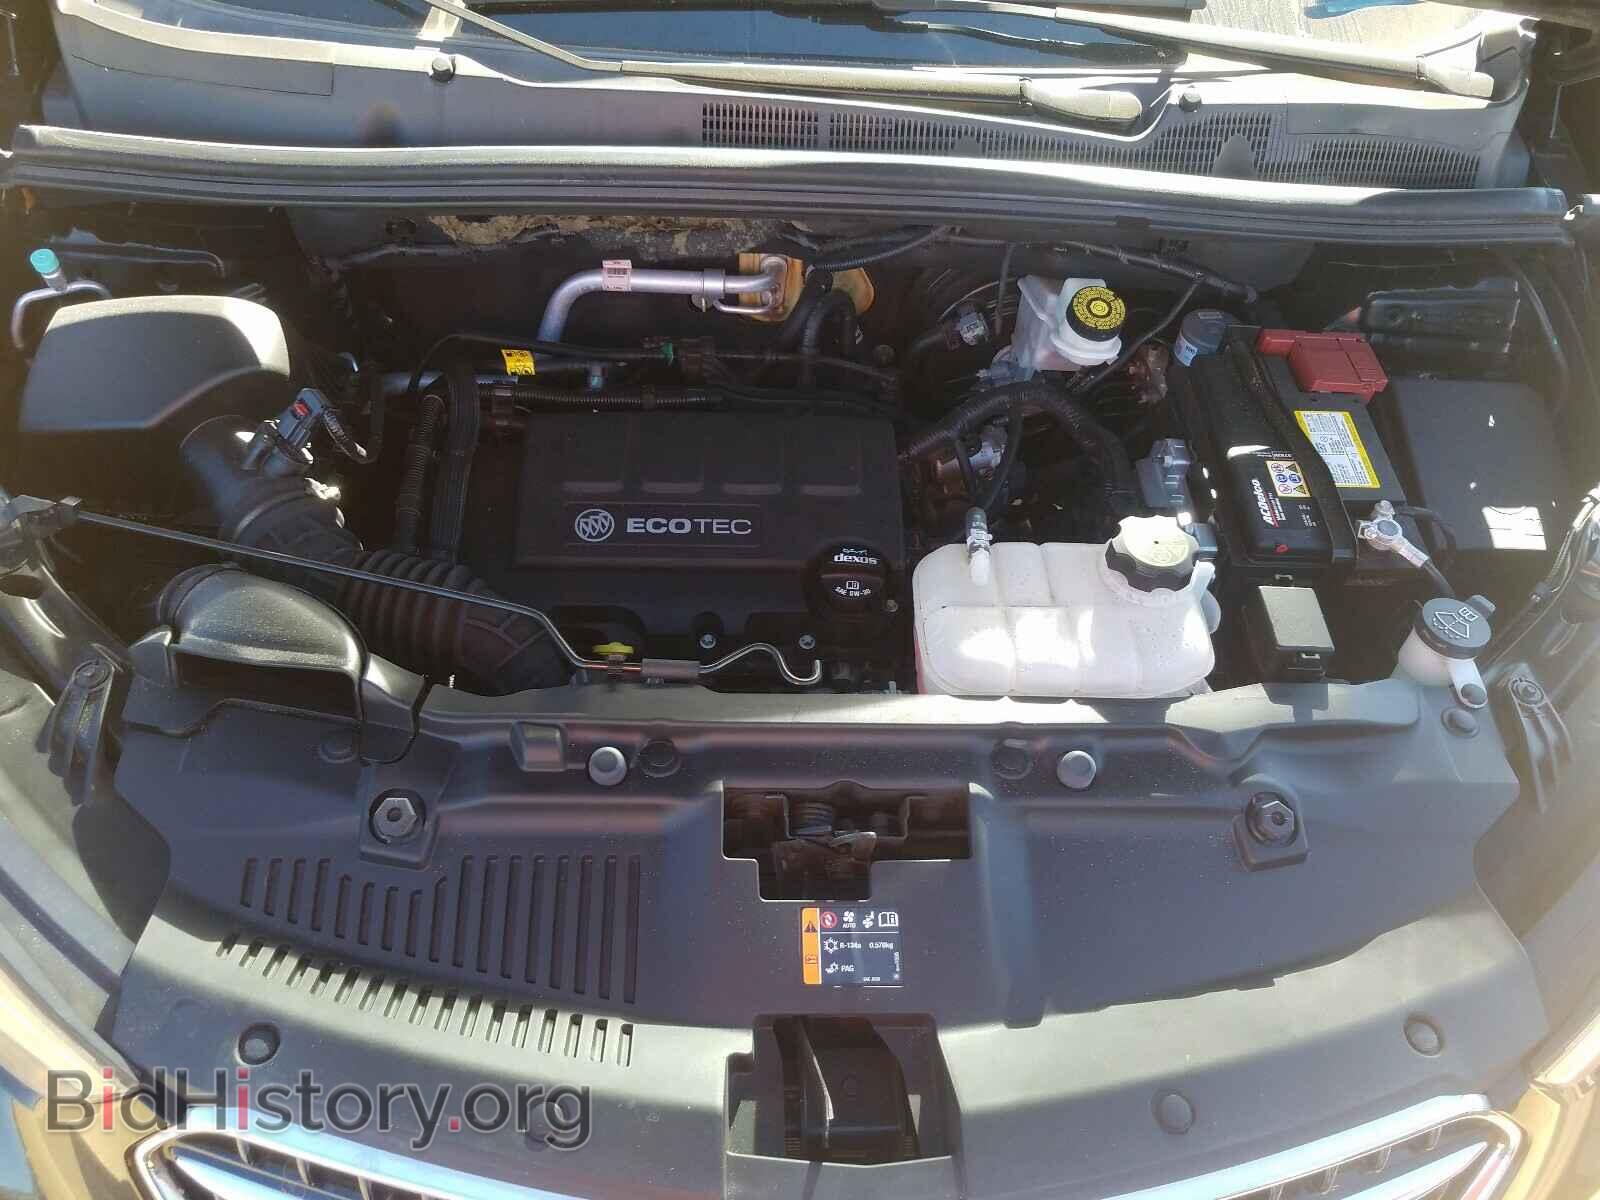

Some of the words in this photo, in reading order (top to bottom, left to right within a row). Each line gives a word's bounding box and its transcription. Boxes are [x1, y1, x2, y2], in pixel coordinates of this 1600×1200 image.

[626, 517, 752, 535] ECOTEC
[834, 553, 877, 564] dexos
[840, 964, 855, 972] PAG
